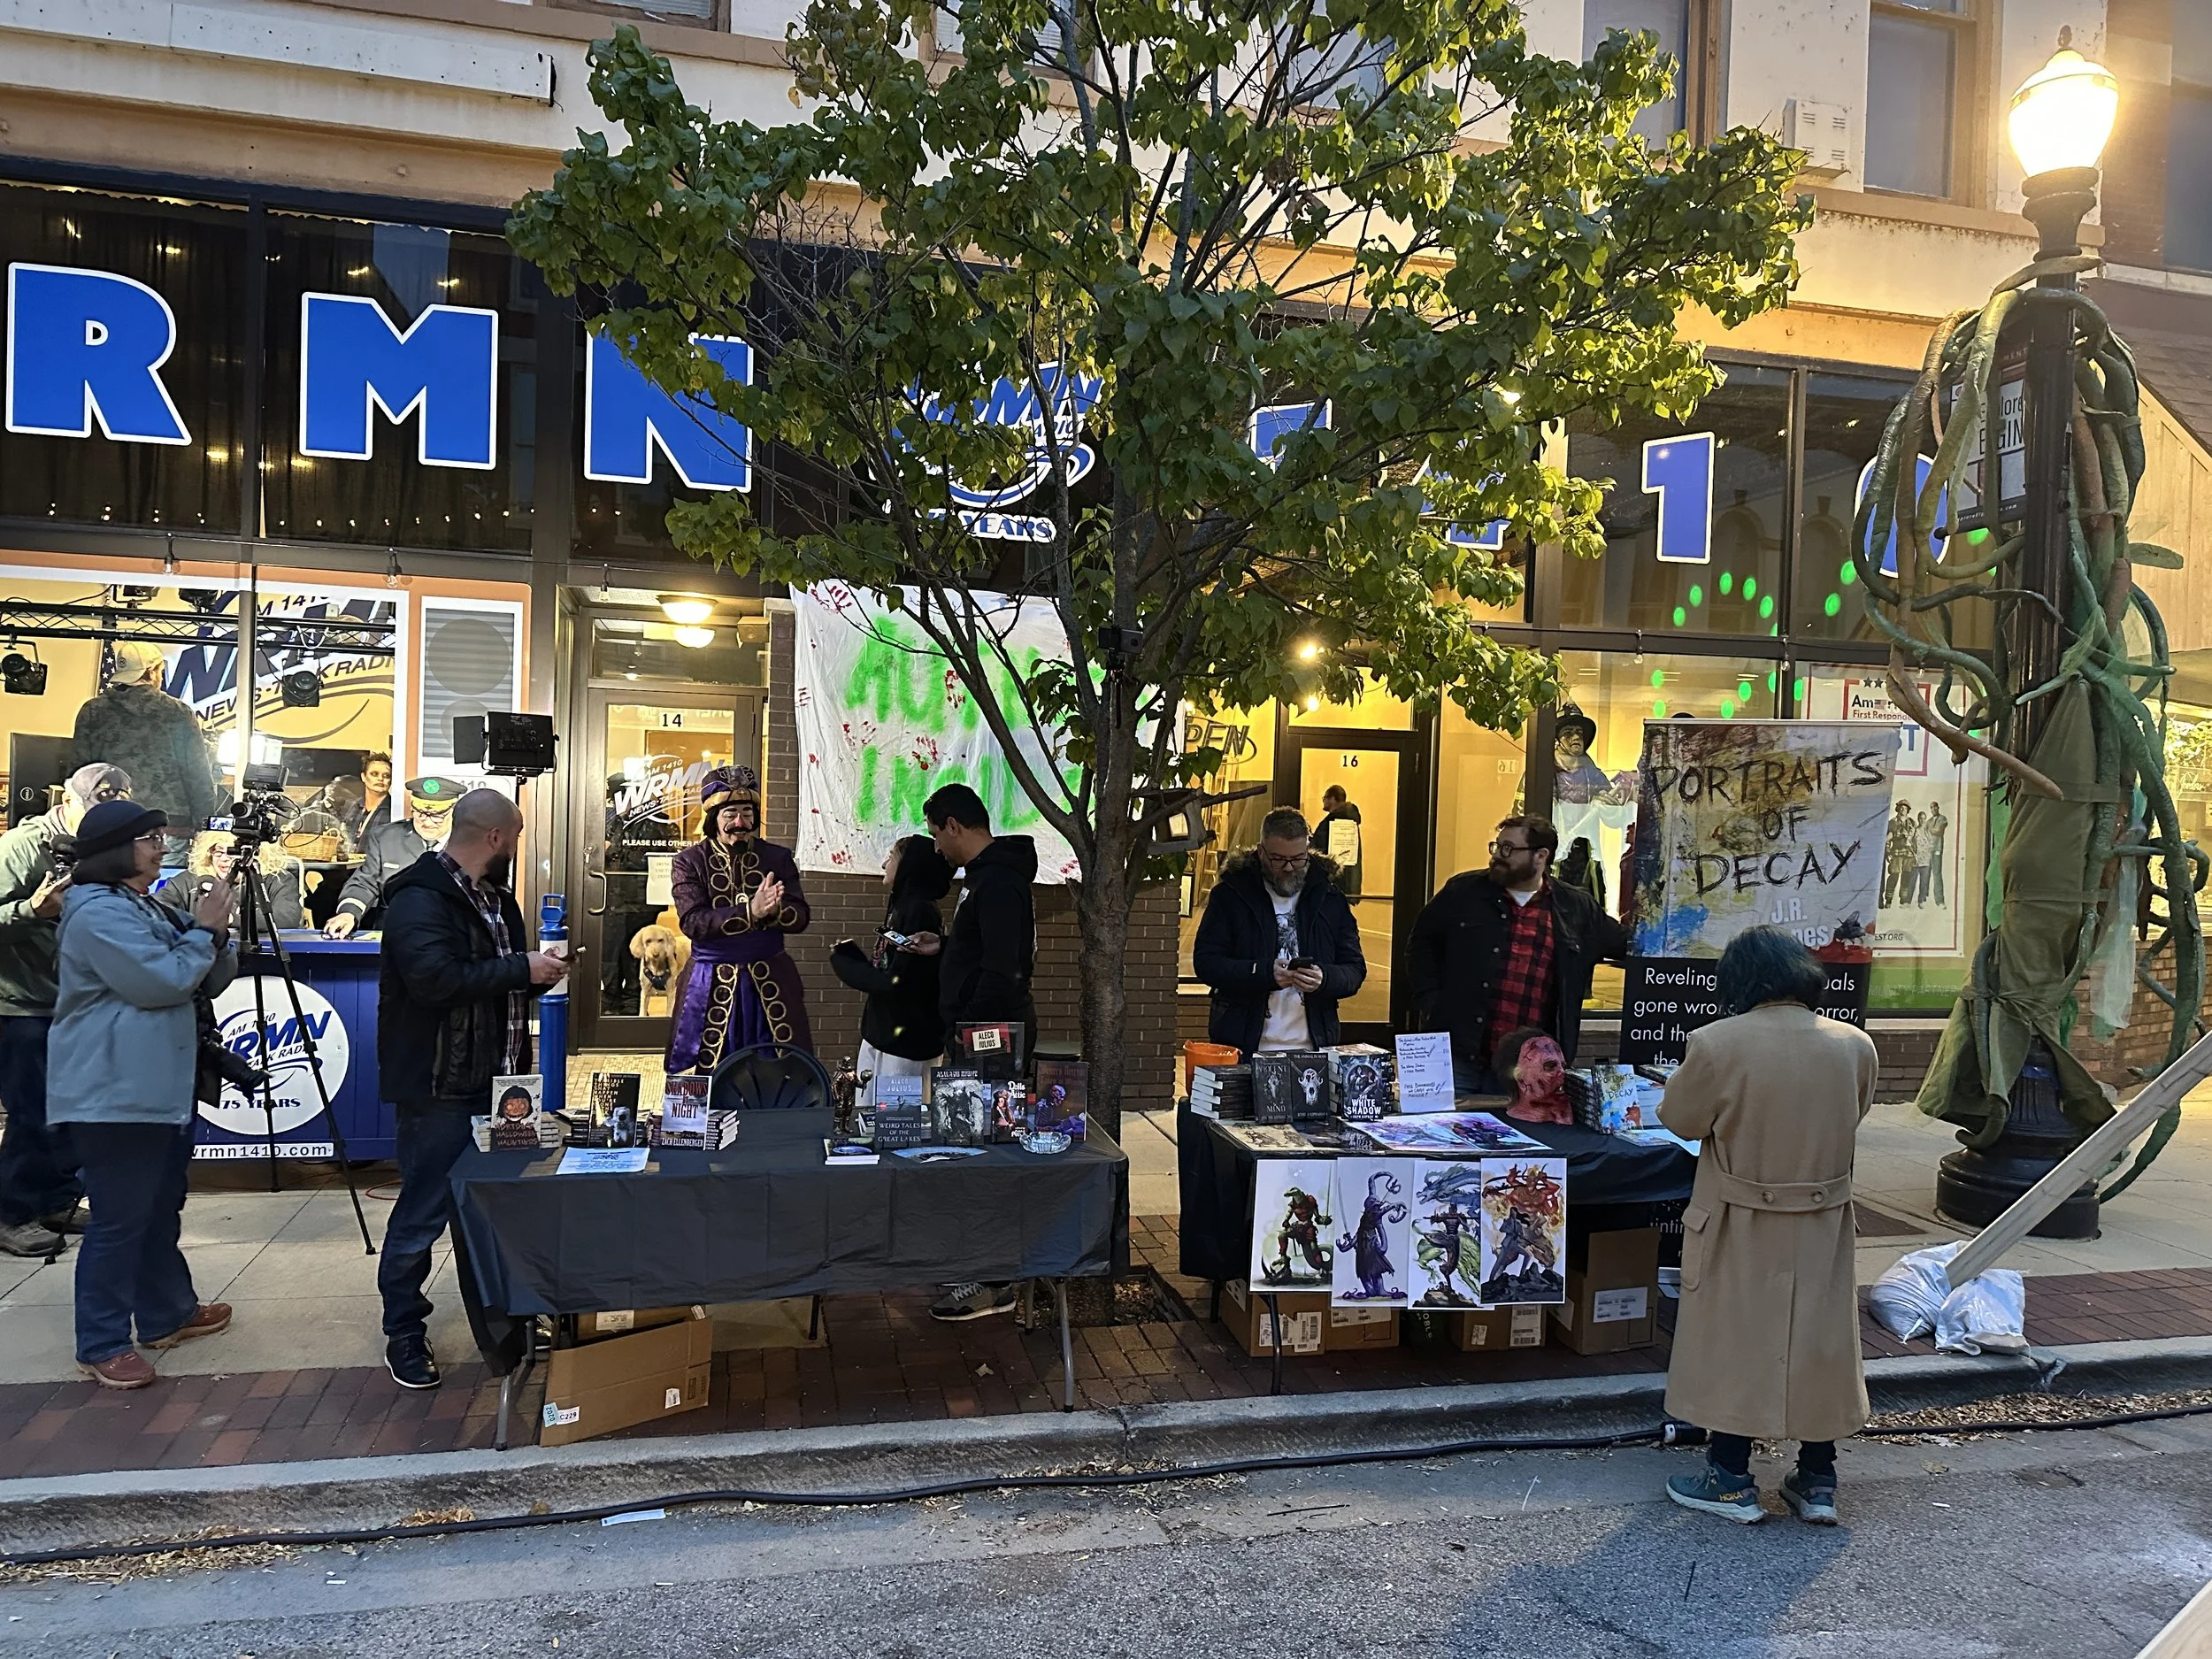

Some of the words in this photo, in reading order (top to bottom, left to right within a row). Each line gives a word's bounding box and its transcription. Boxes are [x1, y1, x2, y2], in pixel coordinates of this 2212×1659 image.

[662, 713, 682, 727] 14
[1853, 710, 1871, 719] First
[1186, 724, 1250, 756] PEN
[663, 758, 683, 771] 1410
[1342, 755, 1359, 768] 16
[1649, 750, 1886, 818] PORTRAITS
[1760, 803, 1811, 843] OF
[1686, 841, 1861, 896] DECAY
[1770, 896, 1809, 925] J.R.
[1645, 967, 1718, 991] Reveling
[1633, 1000, 1678, 1018] gone
[1814, 1005, 1859, 1023] orror,
[223, 1010, 333, 1061] RMN
[227, 1023, 247, 1039] AM
[978, 1031, 995, 1041] ALECO
[1630, 1022, 1664, 1041] and
[979, 1040, 996, 1049] JULIUS
[665, 1081, 708, 1096] SHADOWS
[1007, 1080, 1025, 1092] Dolls
[1608, 1088, 1633, 1100] DECAY
[222, 1099, 241, 1110] 75
[1266, 1104, 1286, 1113] MIND
[1351, 1098, 1376, 1107] WHITE
[672, 1103, 699, 1119] NIGHT
[1347, 1106, 1381, 1115] SHADOW
[559, 1410, 578, 1421] C229
